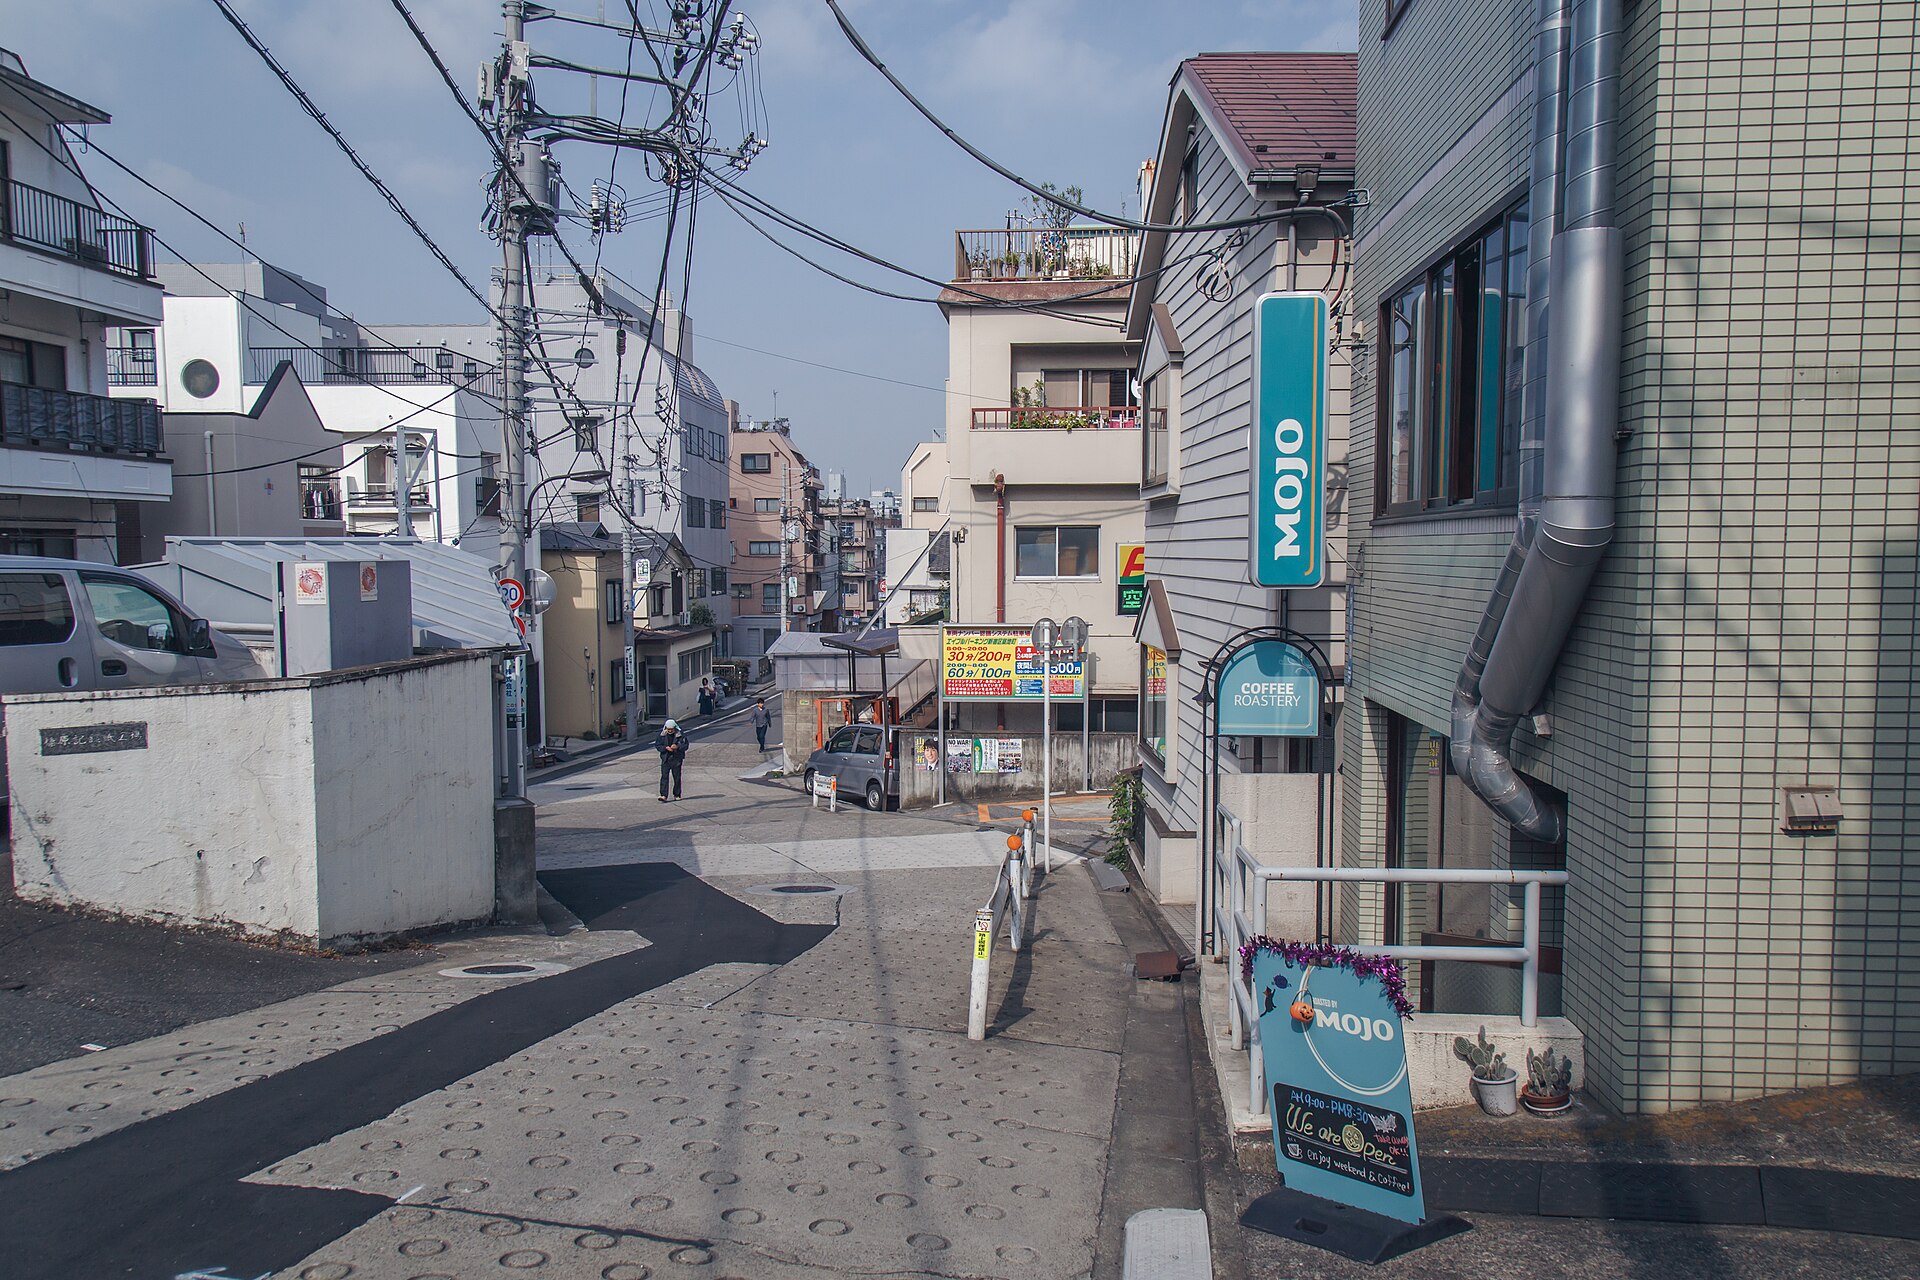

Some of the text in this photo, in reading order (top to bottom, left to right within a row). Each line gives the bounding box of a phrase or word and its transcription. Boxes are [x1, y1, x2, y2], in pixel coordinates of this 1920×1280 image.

[1274, 418, 1308, 561] MOJO
[1234, 694, 1301, 706] ROASTERY
[1241, 682, 1294, 694] COFFEE
[1314, 1008, 1394, 1042] MOJO
[1286, 1102, 1314, 1136] We
[1318, 1126, 1342, 1146] are
[1306, 1148, 1332, 1169] enjoy
[1333, 1159, 1367, 1179] weekend
